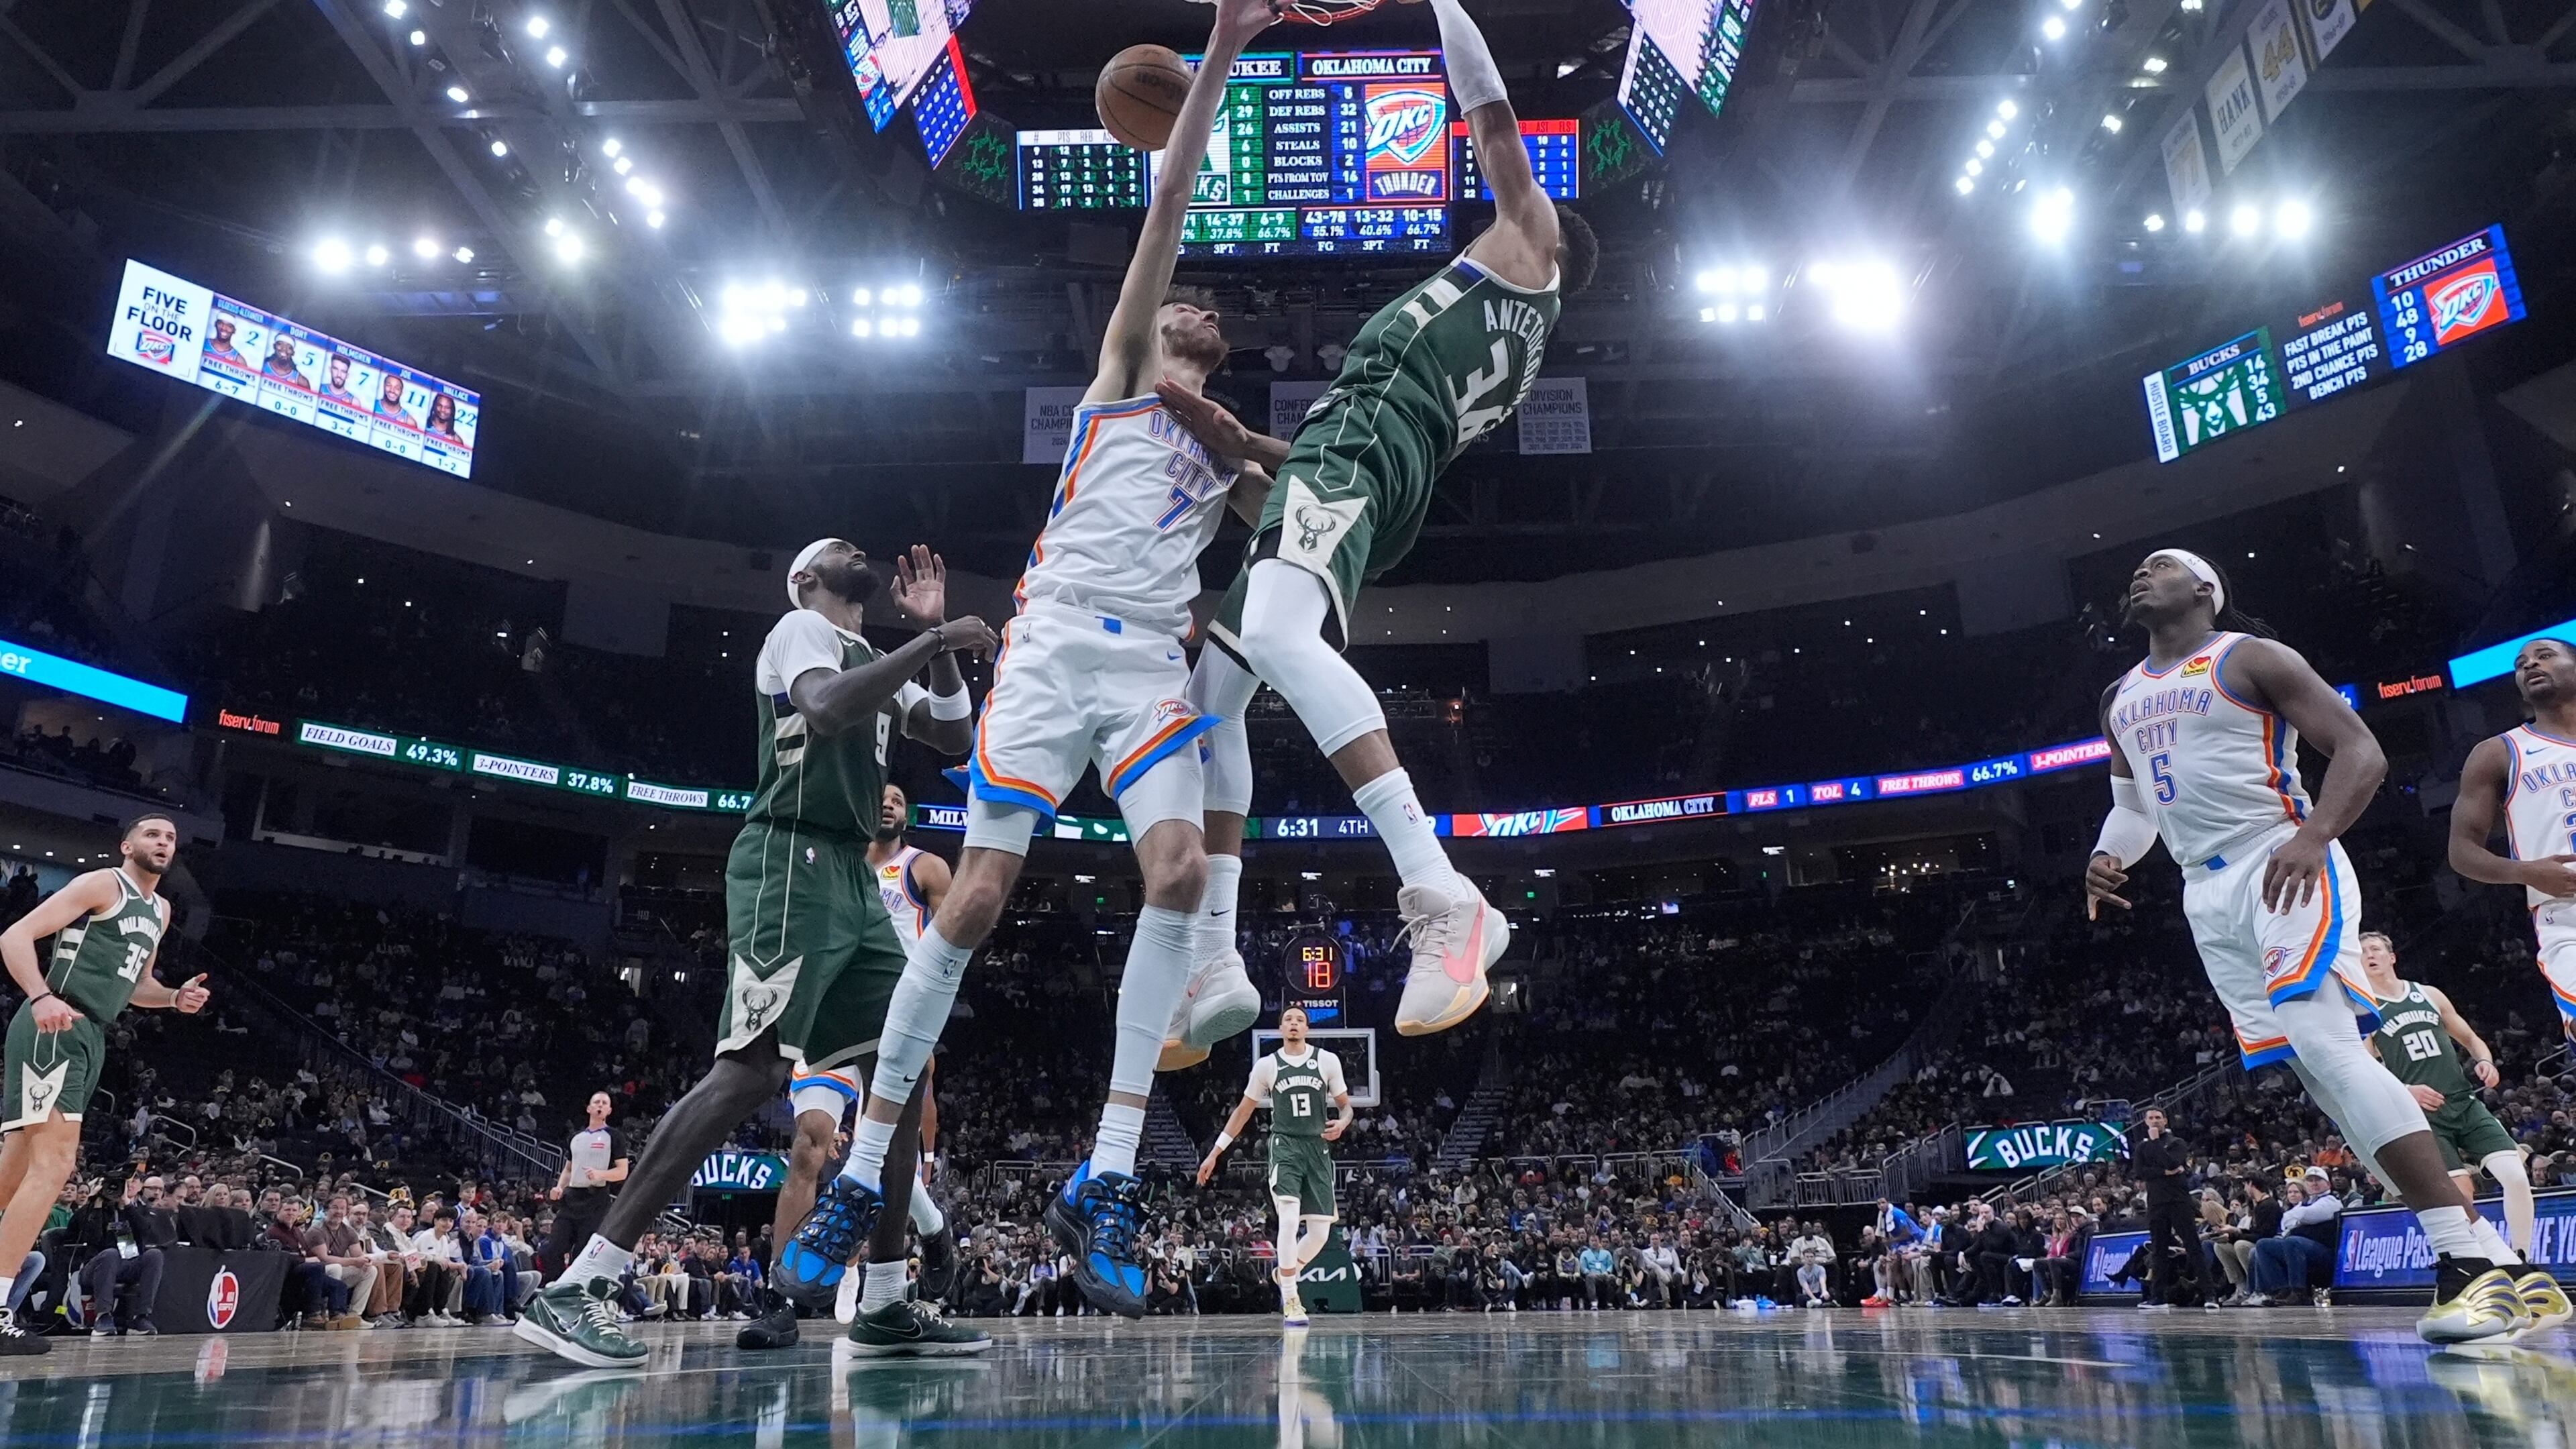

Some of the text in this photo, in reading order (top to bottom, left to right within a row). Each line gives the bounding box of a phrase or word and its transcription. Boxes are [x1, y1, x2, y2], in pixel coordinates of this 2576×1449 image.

[1312, 58, 1431, 75] OKLAHOMA CITY
[1240, 89, 1249, 101] 4
[1269, 89, 1325, 100] OFF REBS
[1237, 105, 1253, 118] 29
[1269, 105, 1325, 117] DEF REBS
[1341, 103, 1356, 115] 32
[1237, 123, 1254, 135] 26
[1274, 123, 1320, 133] ASSISTS
[1341, 121, 1356, 133] 21
[1241, 140, 1250, 152] 6
[1276, 140, 1320, 150] STEALS
[1342, 138, 1357, 150] 10
[1274, 156, 1322, 167] BLOCKS
[1345, 154, 1354, 166] 2
[1268, 172, 1329, 183] PTS FROM TOV
[1342, 170, 1358, 182] 16
[1375, 172, 1436, 195] THUNDER
[1243, 190, 1250, 201] 1
[1268, 189, 1330, 201] CHALLENGES
[1346, 188, 1353, 200] 1
[1205, 213, 1244, 226] 14-37
[1260, 213, 1285, 225] 6-9
[1305, 211, 1346, 224] 43-78
[1354, 210, 1394, 223] 13-32
[1403, 209, 1442, 221] 10-15
[1210, 228, 1243, 239] 37.8%
[1258, 227, 1291, 238] 66.7%
[1313, 225, 1344, 237] 55.1%
[1359, 225, 1393, 235] 40.6%
[1407, 223, 1440, 235] 66.7%
[1214, 244, 1235, 254] 3PT
[1265, 243, 1281, 253] FT
[1318, 241, 1334, 252] FG
[1362, 240, 1385, 251] 3PT
[1414, 239, 1430, 250] FT
[2390, 238, 2486, 287] THUNDER
[142, 286, 187, 315] FIVE
[2391, 290, 2414, 312] 10
[144, 303, 180, 322] ON THE
[2396, 308, 2419, 328] 48
[127, 306, 192, 342] FLOOR
[246, 330, 260, 346] 2
[290, 327, 308, 339] DORT
[2284, 311, 2368, 357] FAST BREAK PTS
[2405, 327, 2416, 344] 9
[302, 352, 315, 366] 5
[336, 344, 371, 364] HOLMGREN
[2286, 327, 2373, 374] PTS IN THE PAINT
[2404, 341, 2428, 363] 28
[2188, 344, 2241, 376] BUCKS
[2245, 354, 2266, 374] 14
[2291, 343, 2378, 390] 2ND CHANCE PTS
[203, 358, 256, 382] FREE THROWS
[400, 369, 413, 381] JOE
[358, 372, 369, 386] 7
[2248, 370, 2269, 390] 34
[2308, 366, 2367, 400] BENCH PTS
[443, 385, 469, 401] WALLACE
[1446, 337, 1509, 443] 34
[1530, 389, 1573, 401] DIVISION
[2256, 387, 2267, 404] 5
[321, 400, 339, 412] FREE
[407, 390, 427, 409] 11
[1040, 405, 1061, 417] NBA
[1523, 402, 1582, 415] CHAMPIONS
[2149, 381, 2173, 453] HUSTLE BOARD
[2255, 402, 2276, 421] 43
[374, 419, 392, 431] FREE
[454, 409, 477, 427] 22
[426, 437, 444, 449] FREE
[1165, 451, 1216, 502] CITY
[1152, 482, 1197, 533] 7
[2112, 687, 2213, 739] OKLAHOMA
[875, 711, 892, 767] 9
[2136, 718, 2177, 753] CITY
[305, 727, 458, 766] FIELD GOALS 49.3%
[2032, 741, 2111, 769] 3-POINTERS
[476, 758, 614, 794] 3-POINTERS 37.8%
[1880, 761, 2017, 792] FREE THROWS 66.7%
[2149, 750, 2178, 806] 5
[630, 786, 751, 810] FREE THROWS 66.7
[1750, 789, 1794, 806] FLS 1
[1813, 782, 1861, 800] TOL 4
[1611, 797, 1715, 822] OKLAHOMA CITY
[1277, 818, 1368, 837] 6:31 4TH
[1303, 947, 1333, 961] 6:31
[1308, 962, 1331, 988] 18
[2381, 1010, 2440, 1038] MILWAUKEE
[2402, 1029, 2443, 1062] 20
[1275, 1075, 1324, 1094] MILWAUKEE
[1289, 1093, 1311, 1117] 13
[1995, 1126, 2094, 1168] BUCKS
[2354, 1230, 2404, 1278] League
